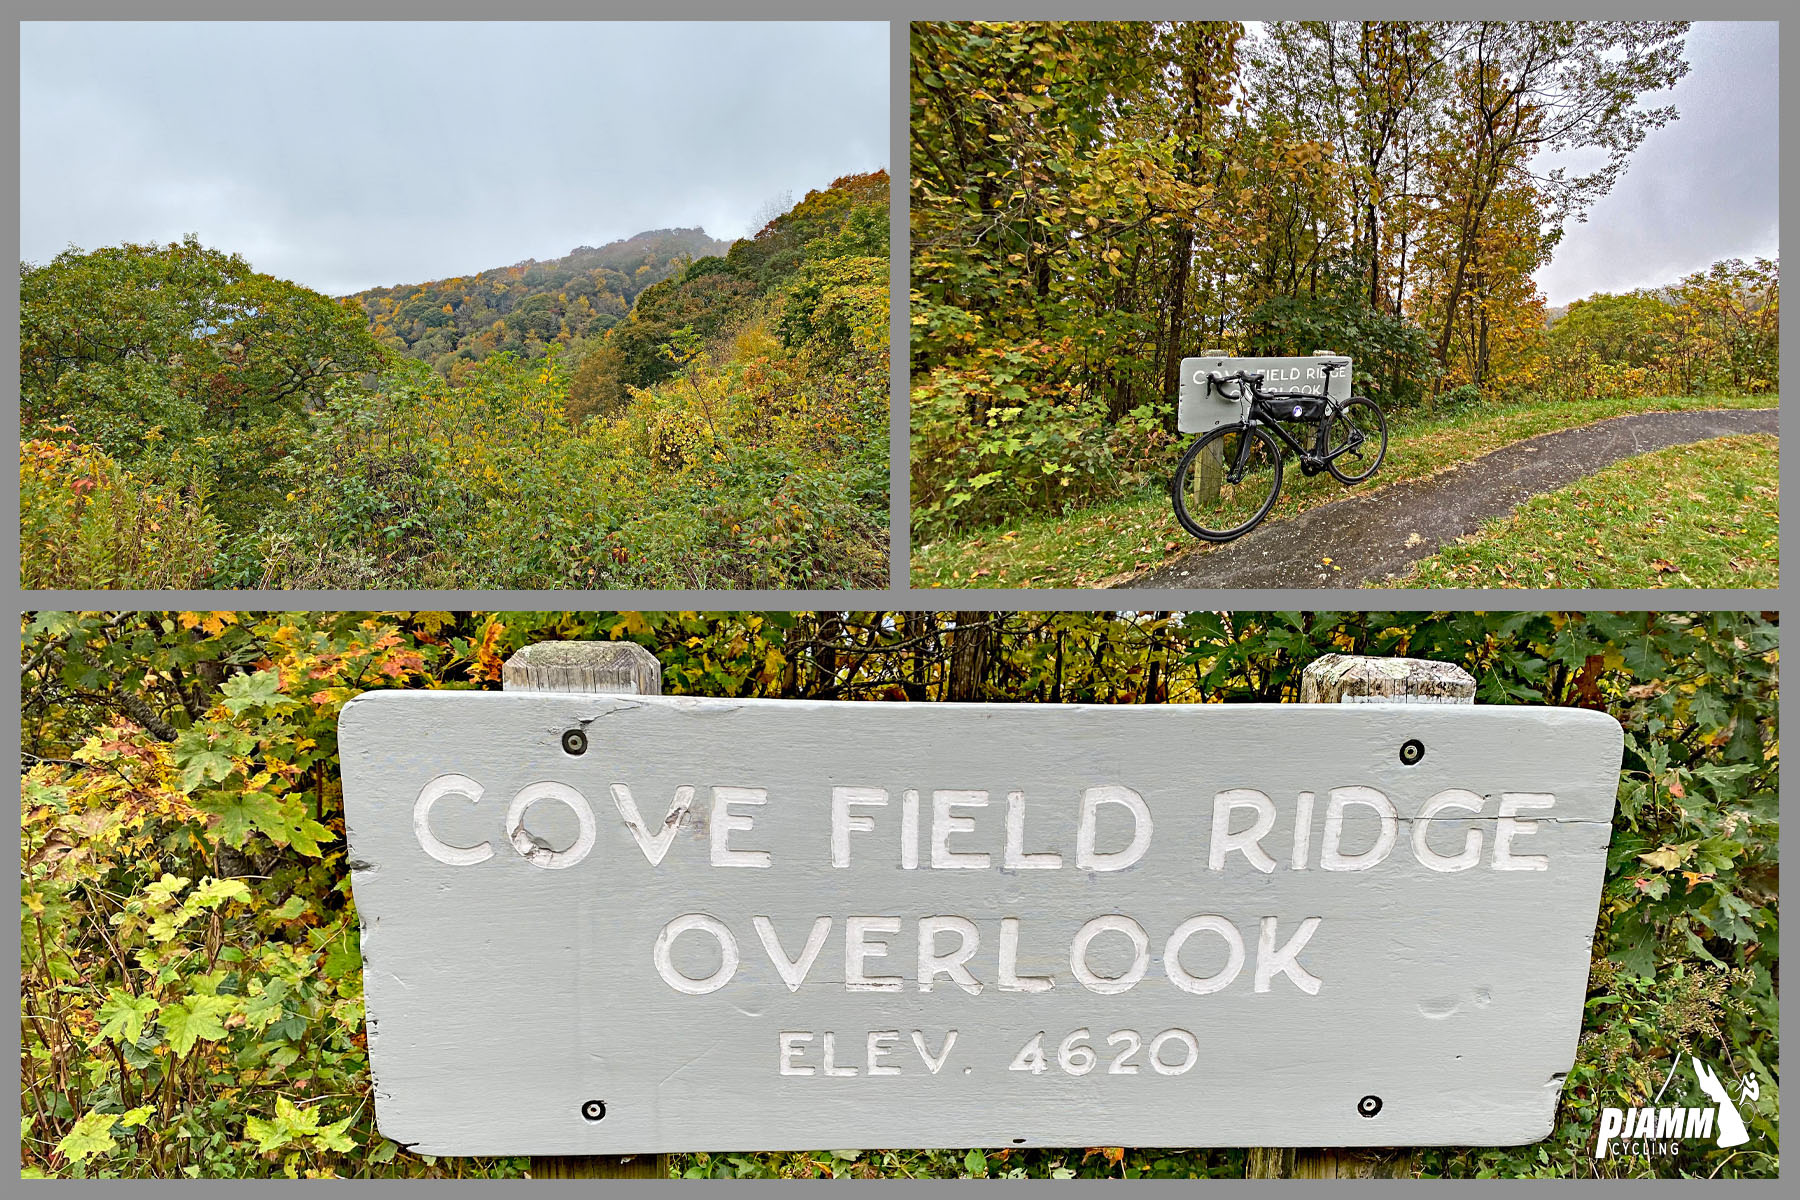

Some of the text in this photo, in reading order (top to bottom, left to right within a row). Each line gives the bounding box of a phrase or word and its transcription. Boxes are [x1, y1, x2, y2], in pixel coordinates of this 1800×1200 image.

[1193, 370, 1248, 385] COV
[413, 773, 1556, 874] COVE FIELD RIDGE
[653, 913, 1323, 996] OVERLOOK
[778, 1026, 1200, 1077] ELEV. 4620
